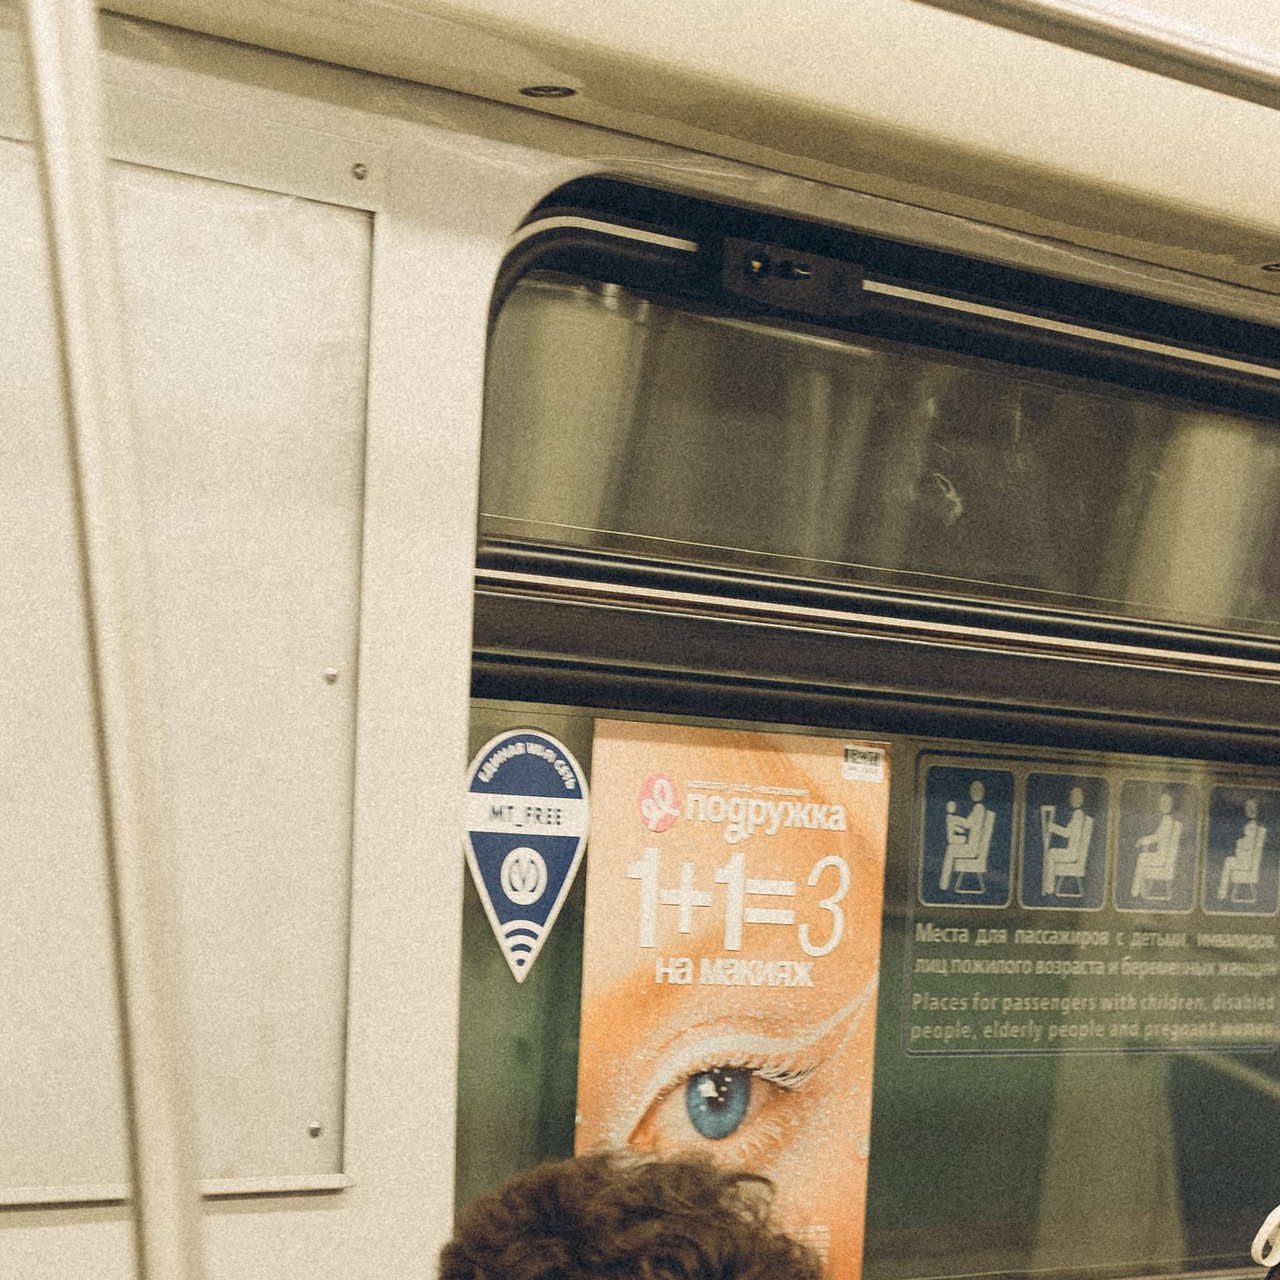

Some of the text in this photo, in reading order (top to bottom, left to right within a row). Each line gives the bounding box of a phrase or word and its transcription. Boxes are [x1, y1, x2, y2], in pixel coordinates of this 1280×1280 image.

[686, 793, 847, 845] подружка
[626, 846, 852, 957] 1+1=3
[914, 922, 970, 944] Места
[974, 928, 1009, 947] для
[1014, 929, 1110, 950] пассажиров
[655, 956, 816, 988] на макияж
[913, 958, 949, 977] лиц
[950, 958, 1033, 975] пожилого
[1035, 959, 1106, 980] возраста
[911, 992, 969, 1011] Places
[972, 991, 1000, 1011] for
[1001, 997, 1097, 1015] passengers
[1099, 993, 1137, 1011] with
[983, 1019, 1042, 1042] elderly
[1048, 1019, 1107, 1042] people
[1108, 1020, 1140, 1038] and
